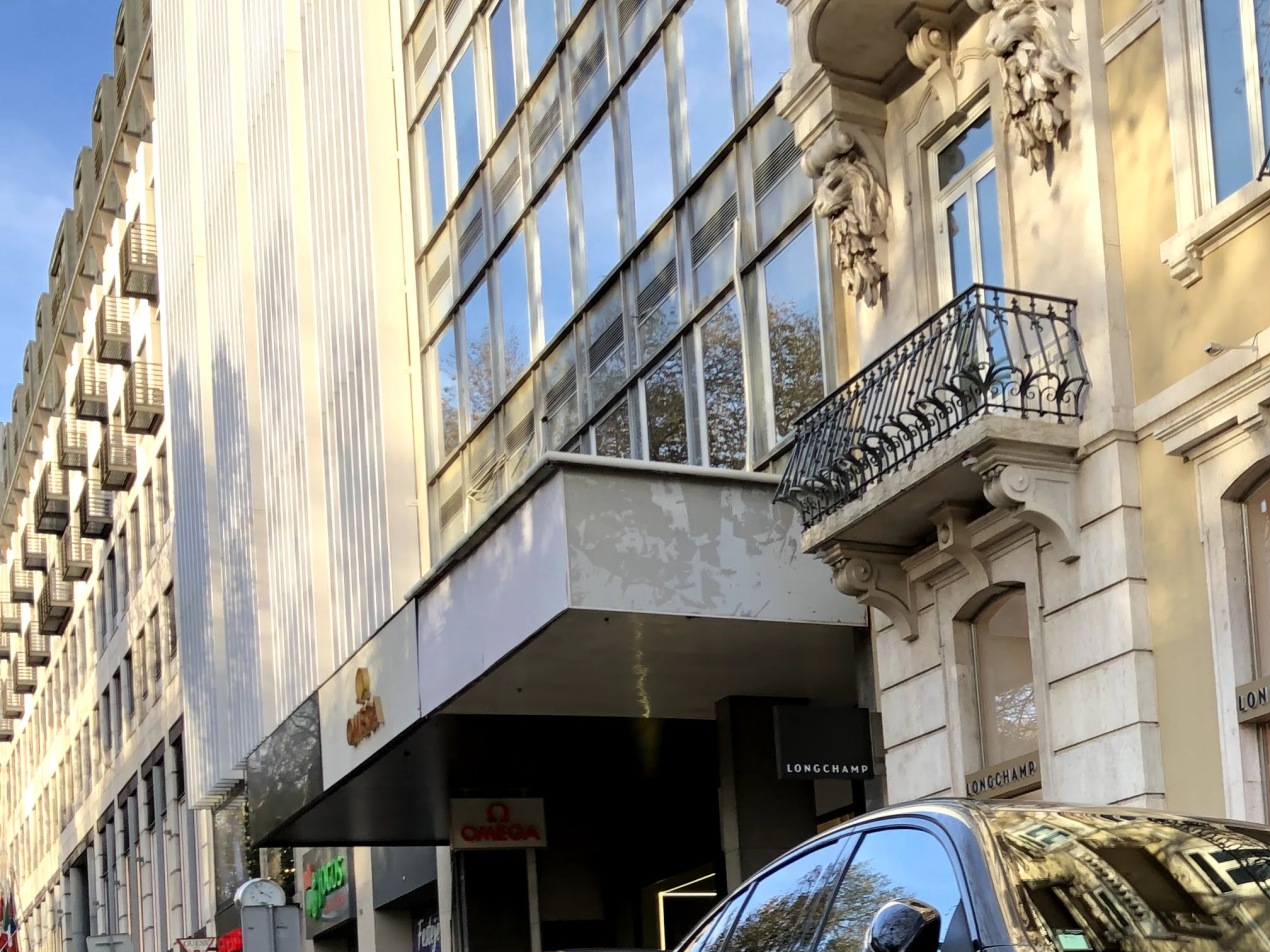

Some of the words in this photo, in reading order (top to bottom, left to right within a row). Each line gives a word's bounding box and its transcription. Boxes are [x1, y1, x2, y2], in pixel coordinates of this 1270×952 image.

[786, 763, 868, 774] LONGCHAMP
[966, 761, 1036, 797] LONGCHAMP
[460, 823, 541, 842] OMEGA
